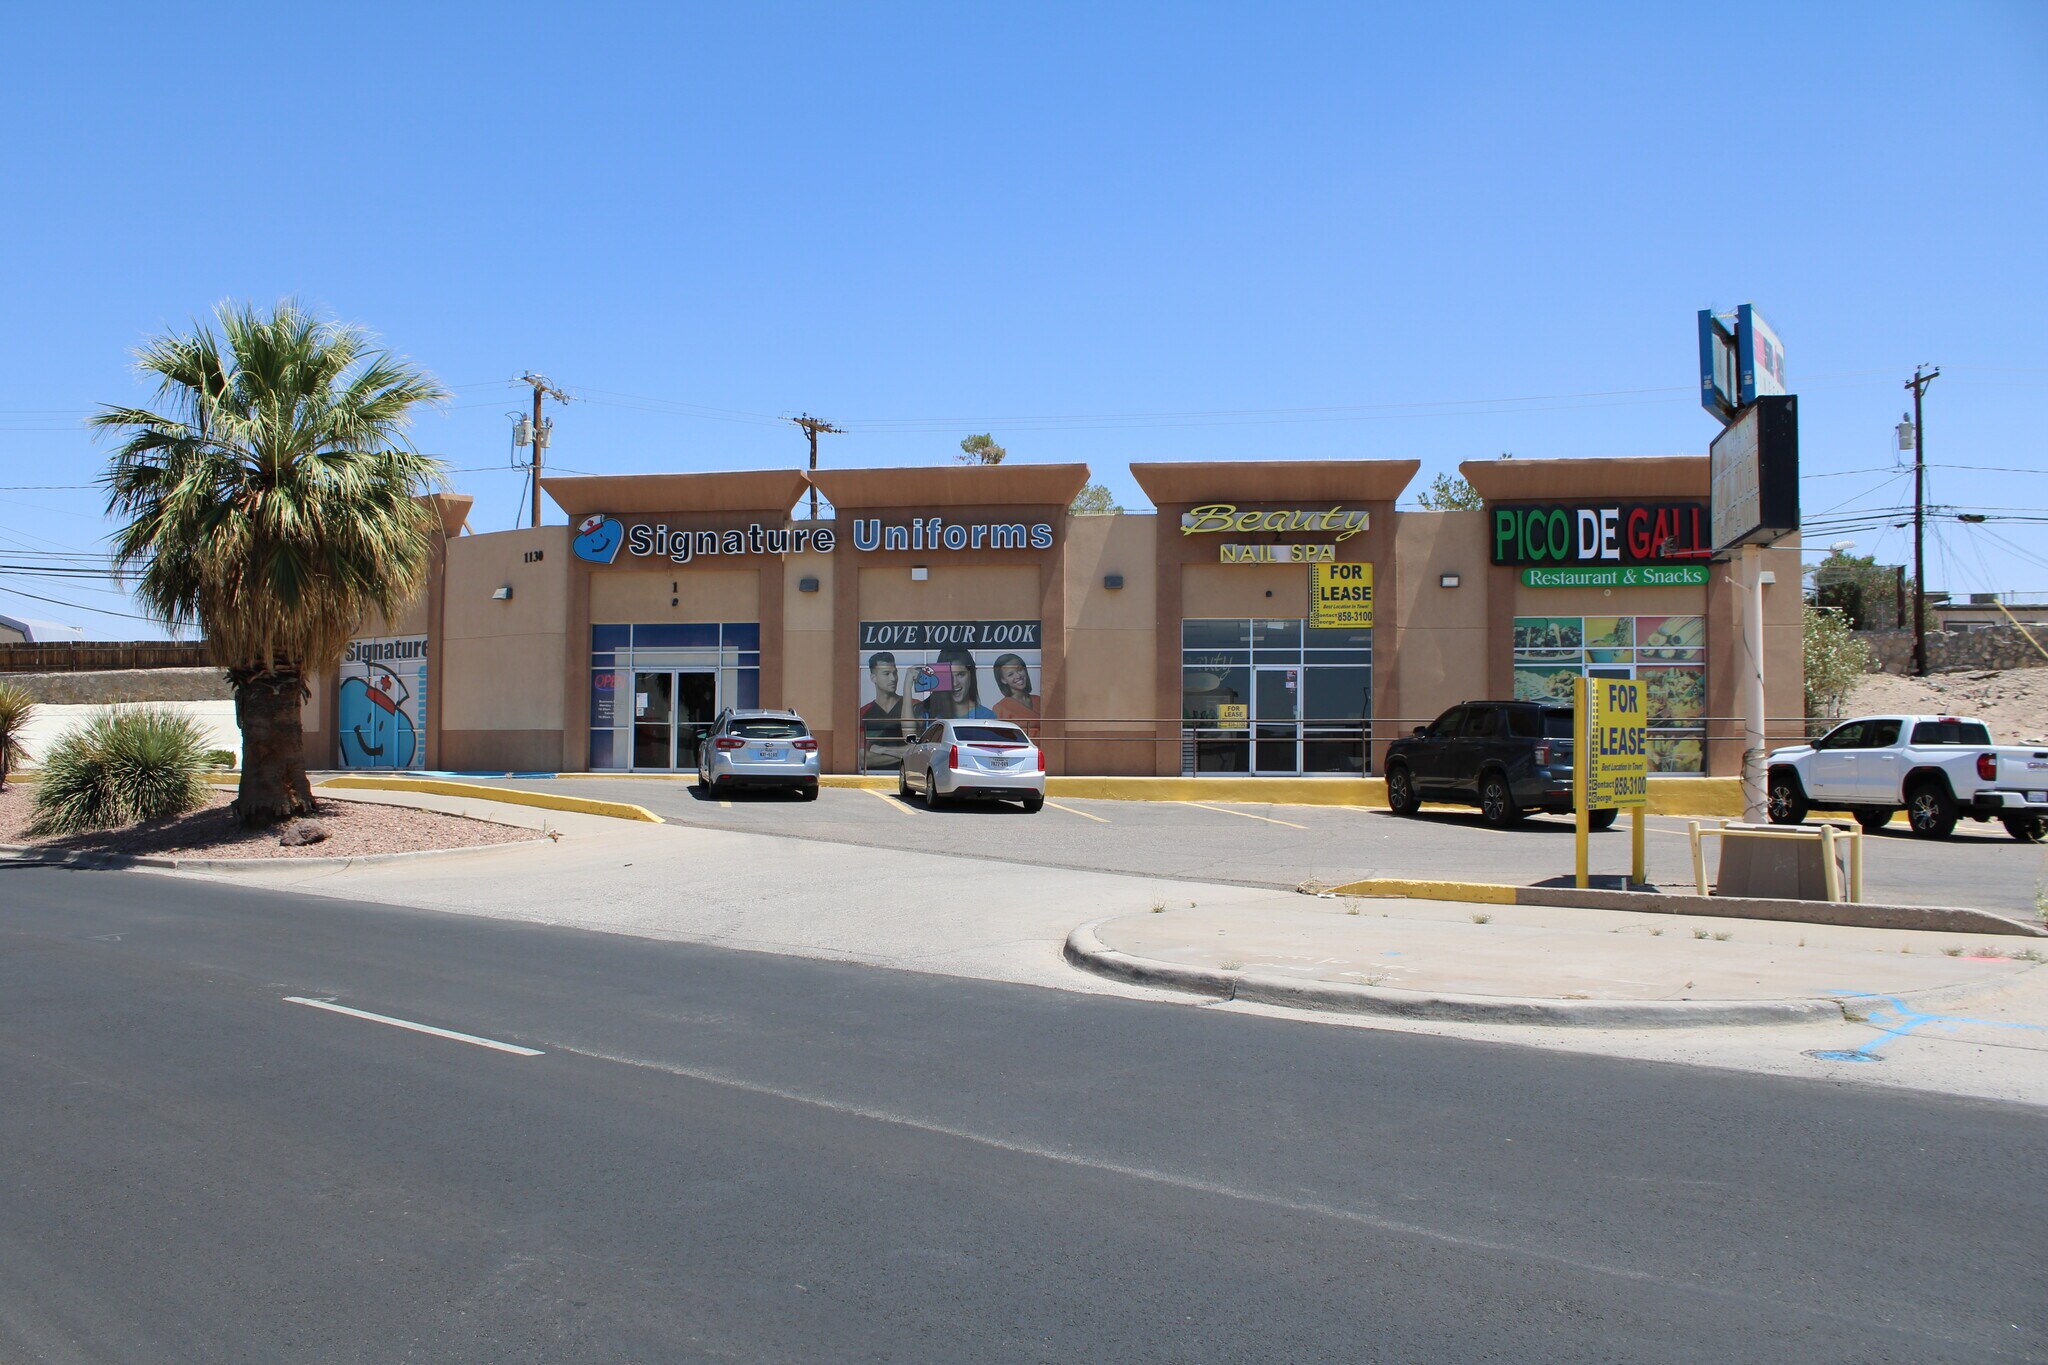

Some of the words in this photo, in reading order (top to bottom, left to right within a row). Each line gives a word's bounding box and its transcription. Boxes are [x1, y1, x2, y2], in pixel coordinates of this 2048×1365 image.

[1180, 504, 1370, 542] Beauty
[629, 523, 836, 564] Signature
[853, 517, 1053, 551] Uniforms
[1495, 509, 1570, 561] PICO
[1576, 507, 1621, 561] DE
[1627, 507, 1712, 560] GALL
[524, 550, 544, 564] 1130
[1219, 544, 1276, 562] NAIL
[1291, 544, 1335, 562] SPA
[1330, 565, 1362, 579] FOR
[1529, 569, 1617, 586] Restaurant
[1623, 568, 1637, 584] &
[1642, 568, 1702, 584] Snacks
[1321, 586, 1372, 601] LEASE
[1337, 611, 1373, 621] 858-3100
[864, 625, 918, 644] LOVE
[924, 625, 976, 643] YOUR
[980, 624, 1037, 643] LOOK
[345, 639, 428, 662] Signature
[1609, 684, 1638, 713] FOR
[1600, 727, 1646, 756] LEASE
[1614, 776, 1646, 796] 858-3100
